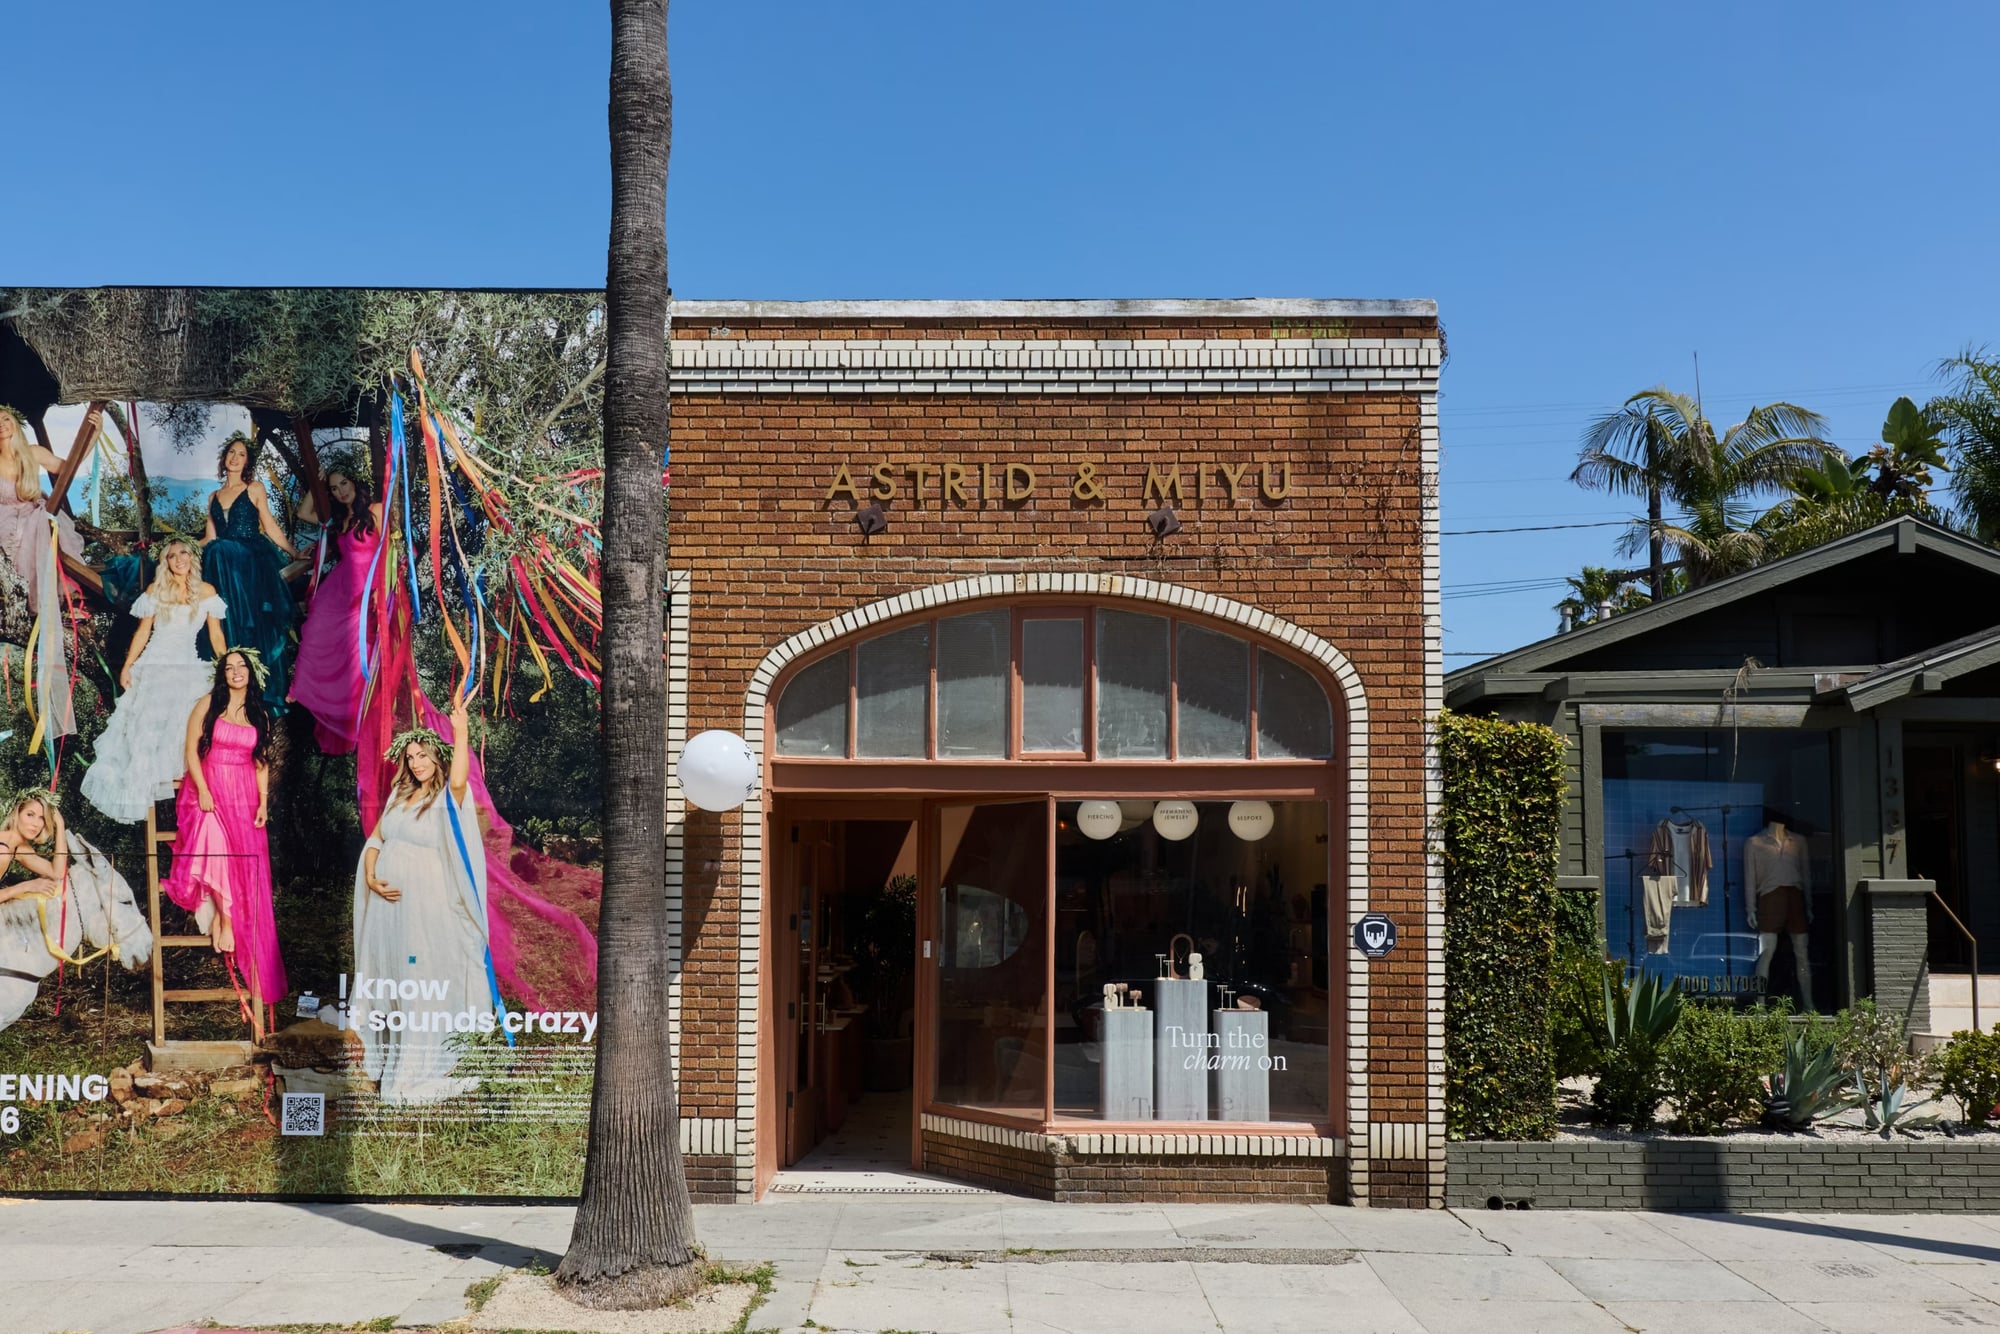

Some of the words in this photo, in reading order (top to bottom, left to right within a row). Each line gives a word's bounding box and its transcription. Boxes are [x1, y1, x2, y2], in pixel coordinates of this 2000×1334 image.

[826, 462, 1037, 502] ASTRID
[1073, 462, 1105, 501] &
[1143, 462, 1292, 501] MIYU
[1087, 813, 1115, 821] PIERCING
[339, 973, 347, 1000] I
[355, 972, 450, 1001] know
[1675, 975, 1710, 993] TODD
[1714, 975, 1768, 993] SNYDER
[338, 1001, 361, 1031] it
[368, 1005, 495, 1033] sounds
[502, 1011, 598, 1043] crazy
[1165, 1025, 1221, 1048] Turn
[1228, 1025, 1265, 1049] the
[1183, 1048, 1251, 1071] charm
[1257, 1055, 1288, 1071] on
[0, 1074, 108, 1101] ENING
[0, 1106, 20, 1134] 6
